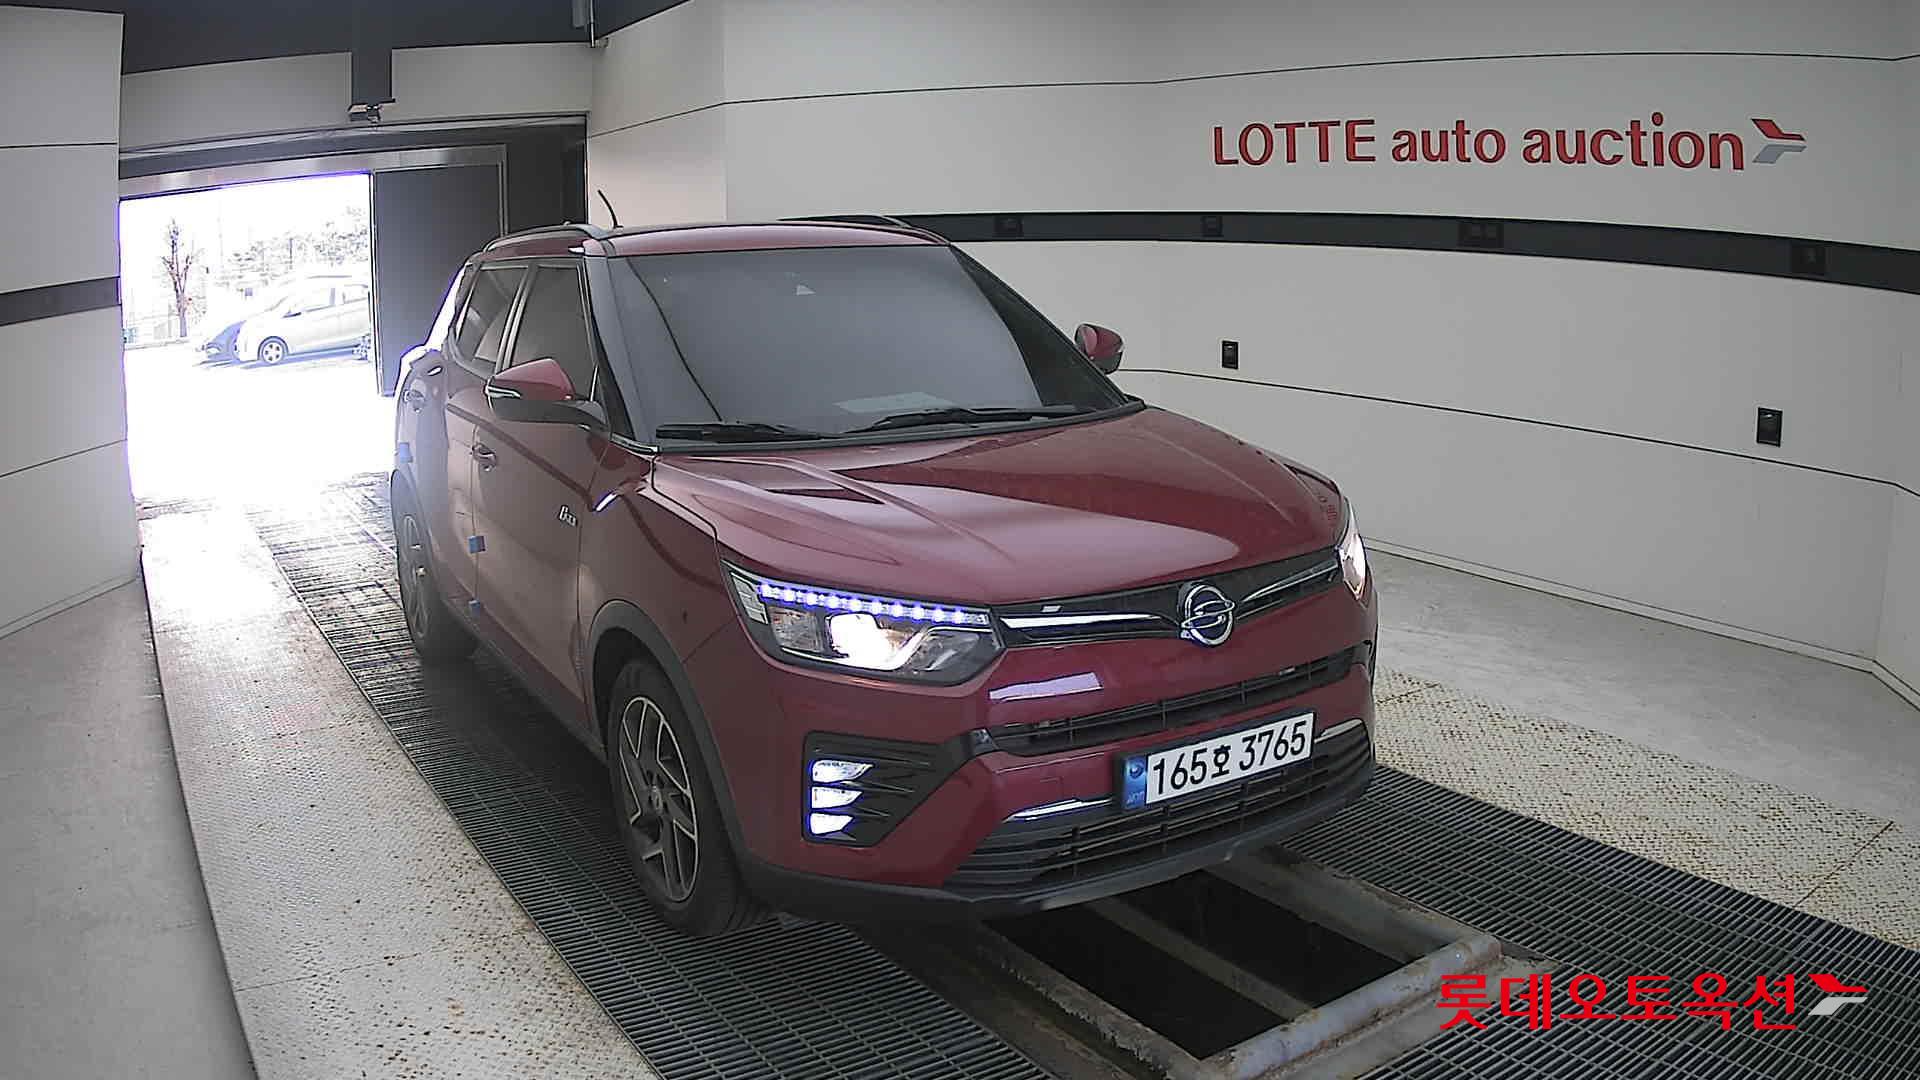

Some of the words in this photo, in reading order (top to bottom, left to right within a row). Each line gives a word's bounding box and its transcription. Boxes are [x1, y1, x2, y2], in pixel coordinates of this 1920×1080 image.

[1213, 118, 1376, 165] LOTTE
[1390, 119, 1507, 164] auto
[1522, 111, 1745, 170] auction
[1152, 744, 1232, 796] 165호
[1238, 719, 1307, 771] 3765
